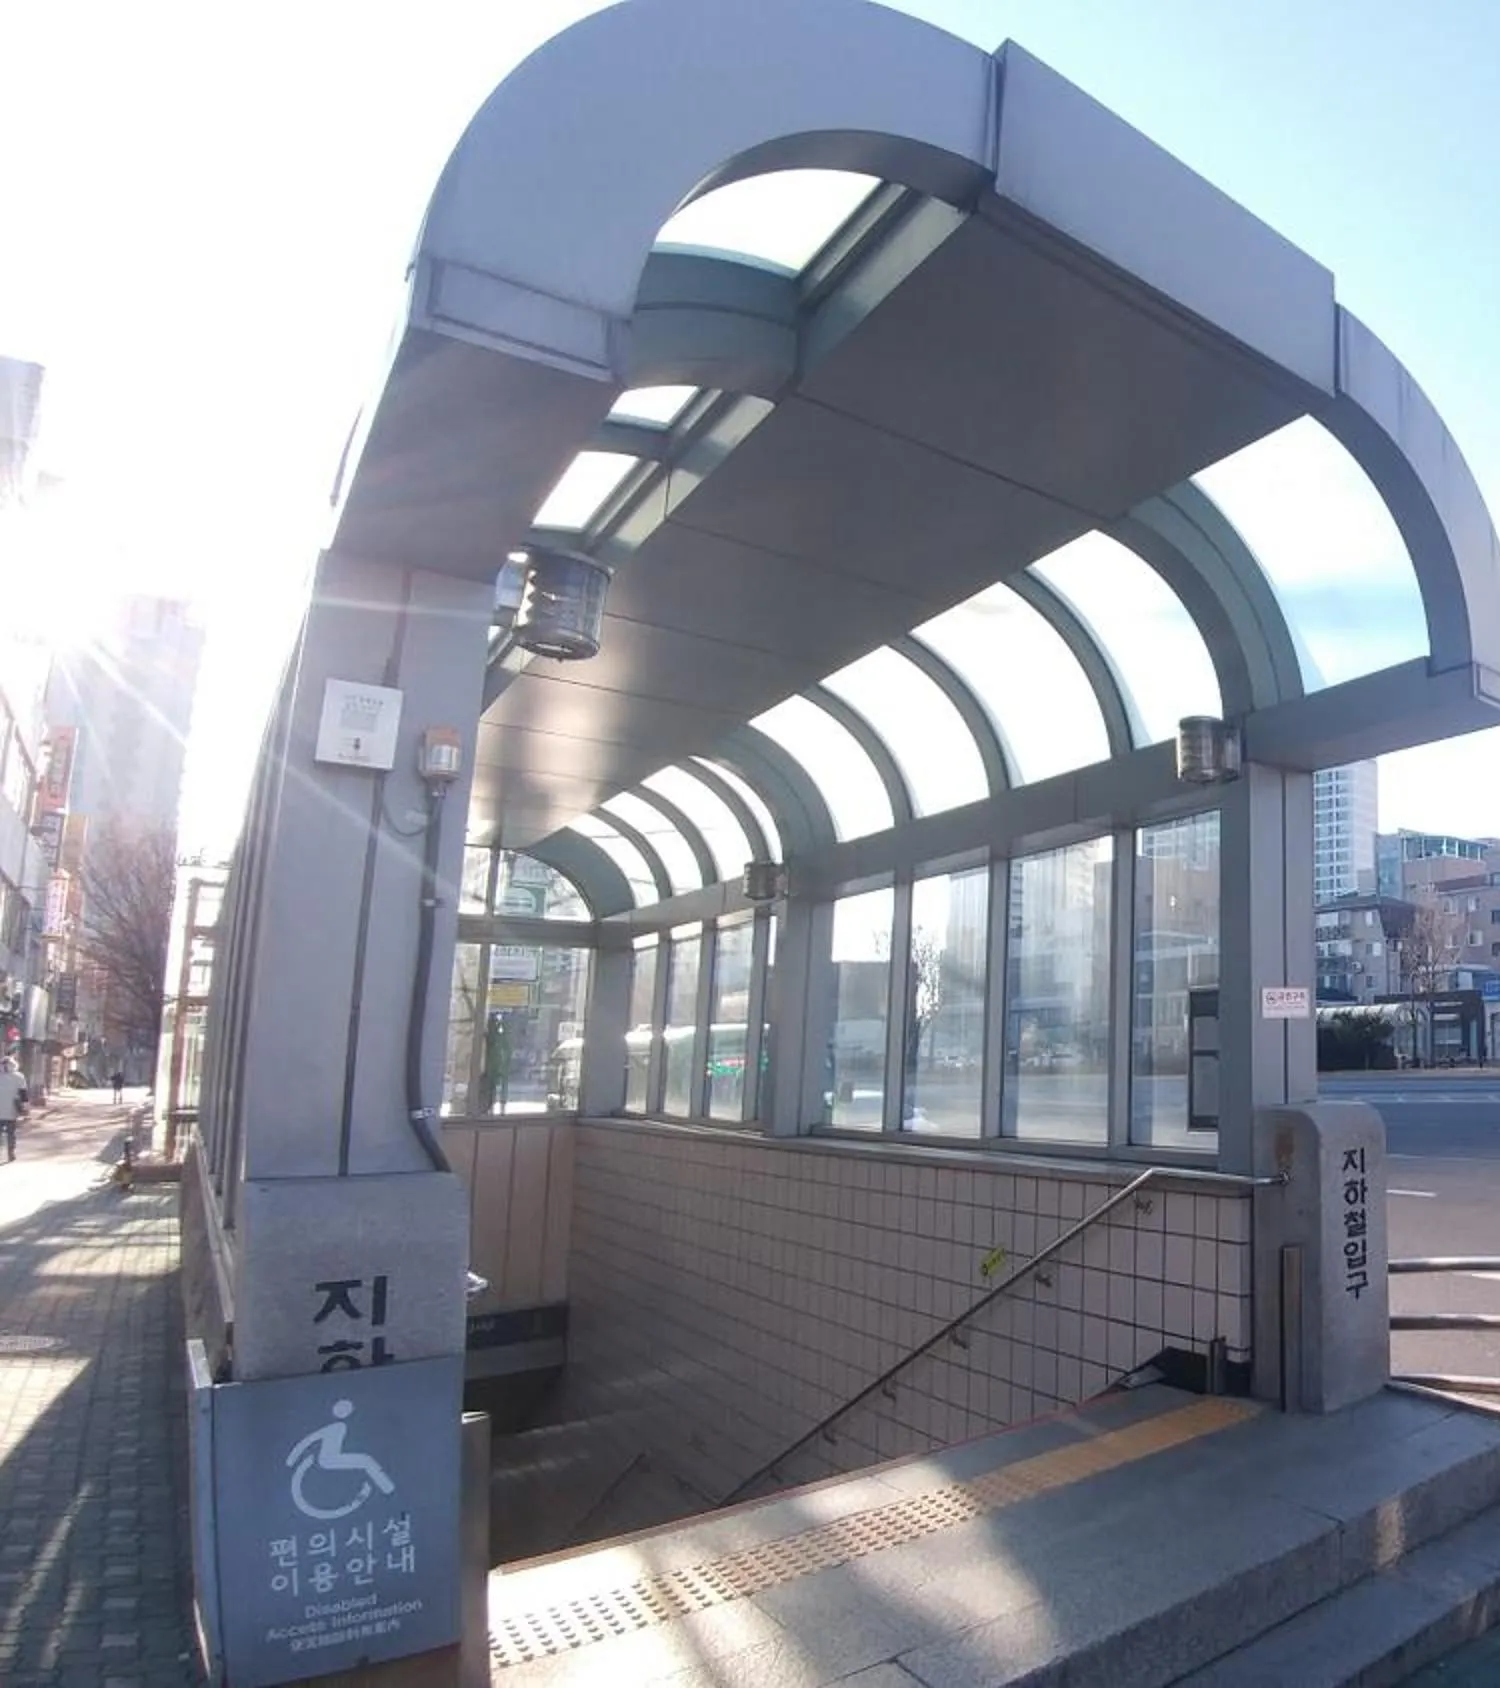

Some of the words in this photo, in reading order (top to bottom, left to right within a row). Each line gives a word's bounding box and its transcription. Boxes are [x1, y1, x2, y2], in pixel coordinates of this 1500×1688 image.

[1342, 1147, 1369, 1300] 지하철입구
[269, 1514, 412, 1568] 편의시설
[270, 1545, 416, 1597] 이용안내
[265, 1620, 328, 1643] Access
[331, 1599, 424, 1629] Information
[305, 1592, 378, 1619] Disabled
